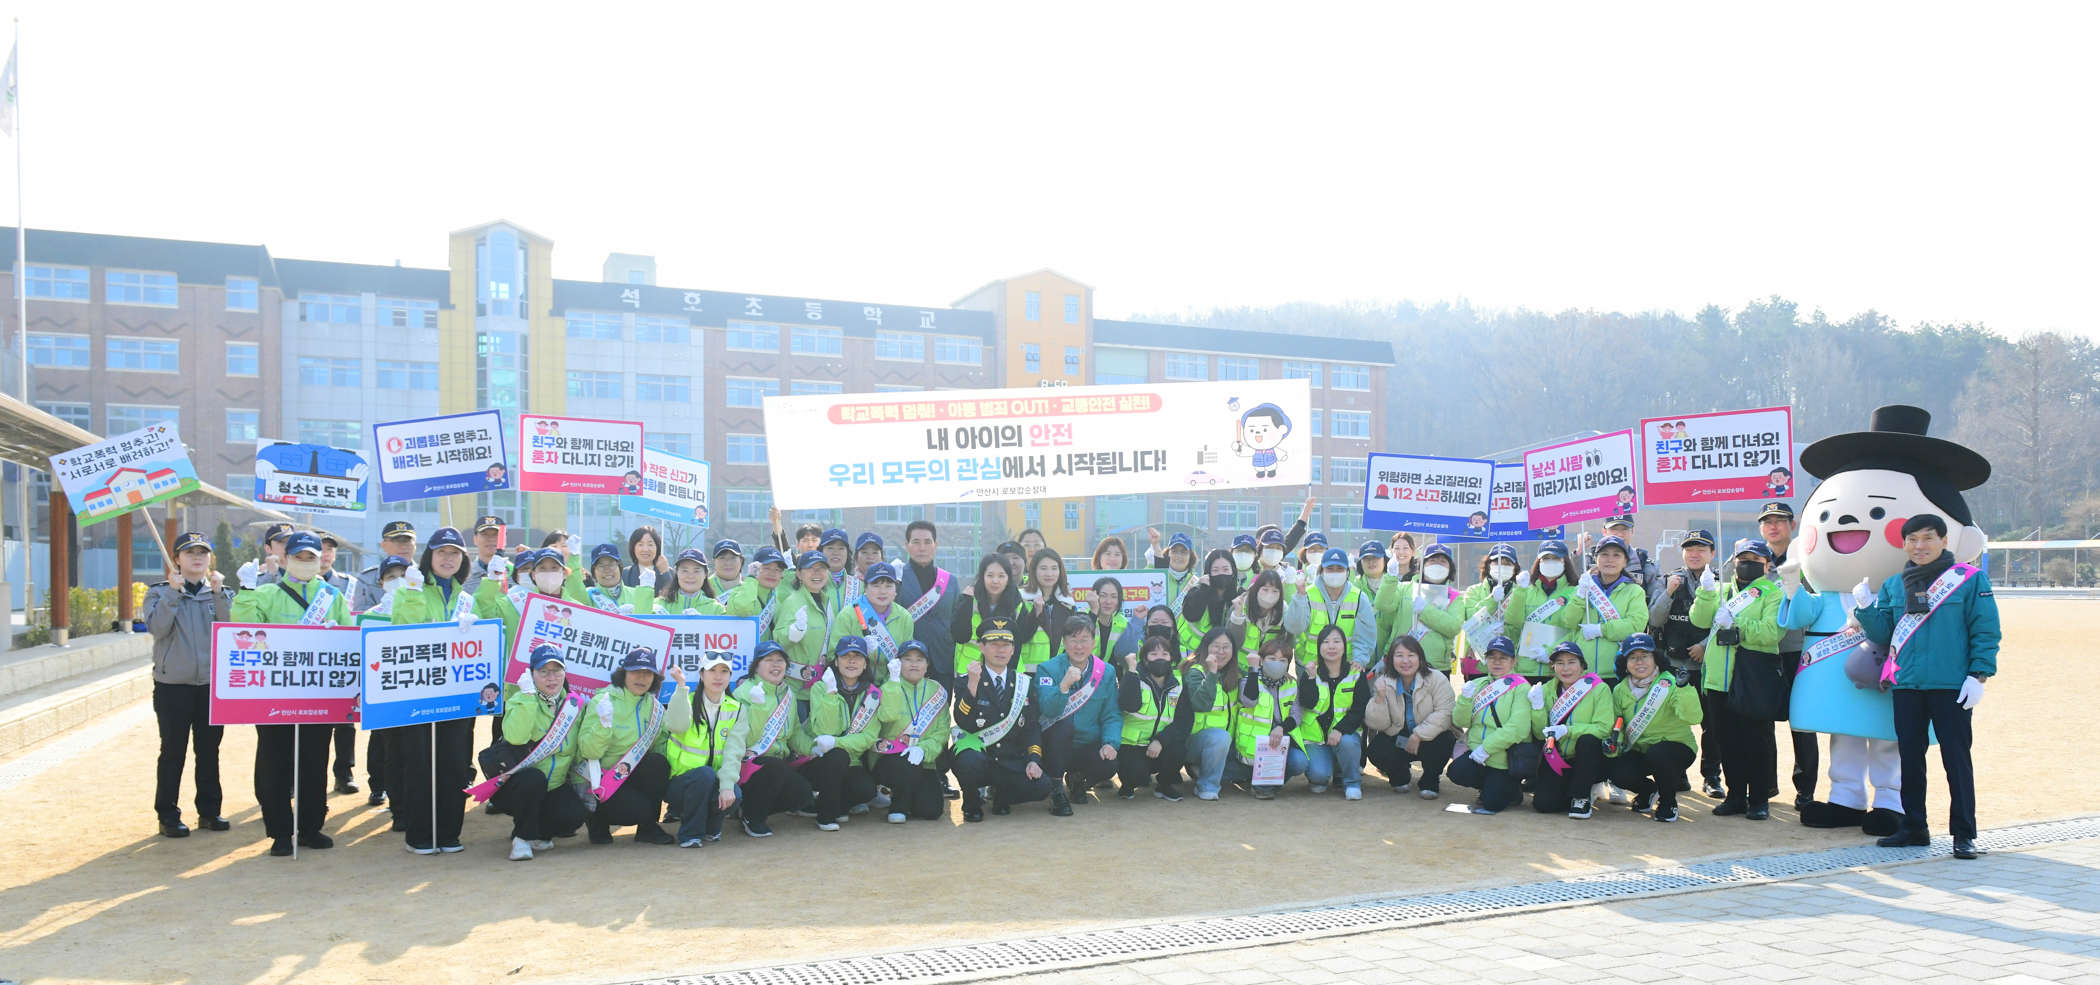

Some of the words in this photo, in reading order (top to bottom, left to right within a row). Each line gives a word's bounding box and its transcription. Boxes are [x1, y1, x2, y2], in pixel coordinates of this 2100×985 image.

[841, 404, 899, 422] 학교폭력
[902, 403, 936, 420] 멈춰!
[948, 402, 977, 418] 아동
[980, 400, 1008, 417] 범죄
[1011, 399, 1049, 415] OUT!
[1061, 397, 1119, 413] 교통안전
[1119, 395, 1150, 411] 실천!
[405, 432, 450, 450] 괴롭힘은
[453, 428, 492, 444] 멈추고,
[532, 435, 568, 449] 친구와
[571, 437, 593, 451] 함께
[597, 439, 634, 453] 다녀요!
[927, 428, 949, 450] 내
[955, 425, 1023, 449] 아이의
[1029, 423, 1073, 447] 안전
[1656, 438, 1697, 455] 친구와
[1701, 435, 1728, 451] 함께
[1732, 431, 1780, 449] 다녀요!
[70, 445, 117, 466] 학교폭력
[120, 432, 159, 452] 멈추고!
[70, 458, 117, 480] 서로서로
[119, 442, 170, 464] 배려하고!
[393, 450, 433, 469] 배려는
[436, 445, 492, 465] 시작해요!
[532, 450, 559, 465] 혼자
[562, 452, 601, 467] 다니지
[604, 454, 634, 469] 않기!
[1656, 455, 1688, 473] 혼자
[1691, 452, 1739, 471] 다니지
[1743, 448, 1781, 467] 않기!
[649, 462, 667, 477] 작은
[669, 465, 698, 486] 신고가
[829, 462, 874, 487] 우리
[882, 459, 950, 483] 모두의
[957, 454, 1046, 481] 관심에서
[1052, 450, 1167, 476] 시작됩니다!
[1532, 457, 1555, 477] 낯선
[1559, 453, 1583, 472] 사람
[278, 481, 318, 497] 청소년
[323, 485, 350, 499] 도박
[976, 488, 999, 497] 안산시
[1002, 486, 1047, 495] 로보캅순찰대
[1378, 471, 1421, 486] 위험하면
[1424, 472, 1483, 489] 소리질러요!
[1534, 475, 1581, 498] 따라가지
[1585, 466, 1628, 489] 않아요!
[669, 483, 706, 503] 만듭니다
[1393, 487, 1412, 501] 112
[1415, 488, 1481, 506] 신고하세요!
[534, 620, 578, 643] 친구와
[580, 631, 609, 651] 함께
[704, 633, 738, 650] NO!
[229, 650, 278, 667] 친구와
[283, 651, 313, 667] 함께
[381, 642, 447, 665] 학교폭력
[451, 640, 483, 659] NO!
[566, 646, 613, 671] 다니지
[229, 669, 265, 688] 혼자
[270, 670, 323, 687] 다니지
[381, 667, 448, 690] 친구사랑
[452, 663, 491, 683] YES!
[1552, 698, 1564, 711] 안전
[1562, 686, 1575, 699] 아동
[1645, 685, 1661, 706] 어린이
